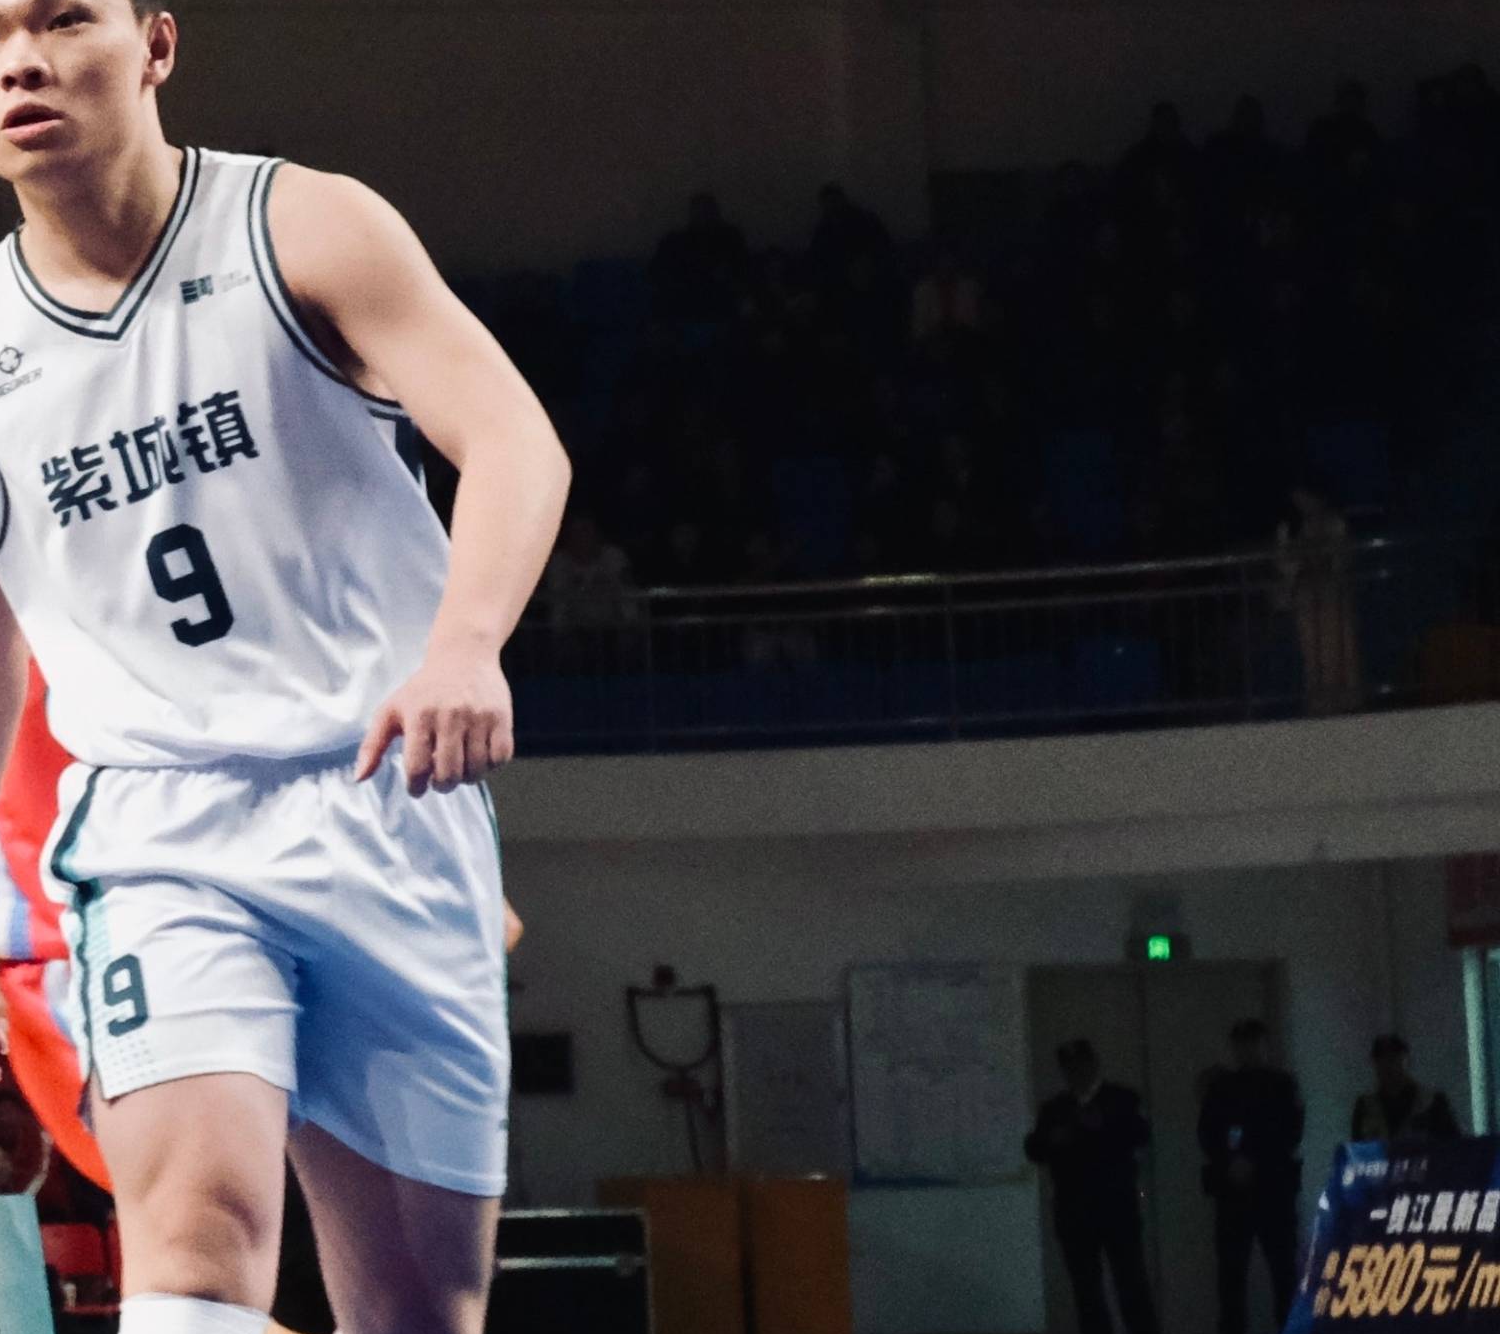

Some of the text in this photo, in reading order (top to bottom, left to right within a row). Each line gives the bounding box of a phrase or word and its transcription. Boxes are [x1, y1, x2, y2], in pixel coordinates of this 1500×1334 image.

[41, 390, 260, 528] 紫城镇
[145, 523, 234, 647] 9
[103, 954, 149, 1037] 9
